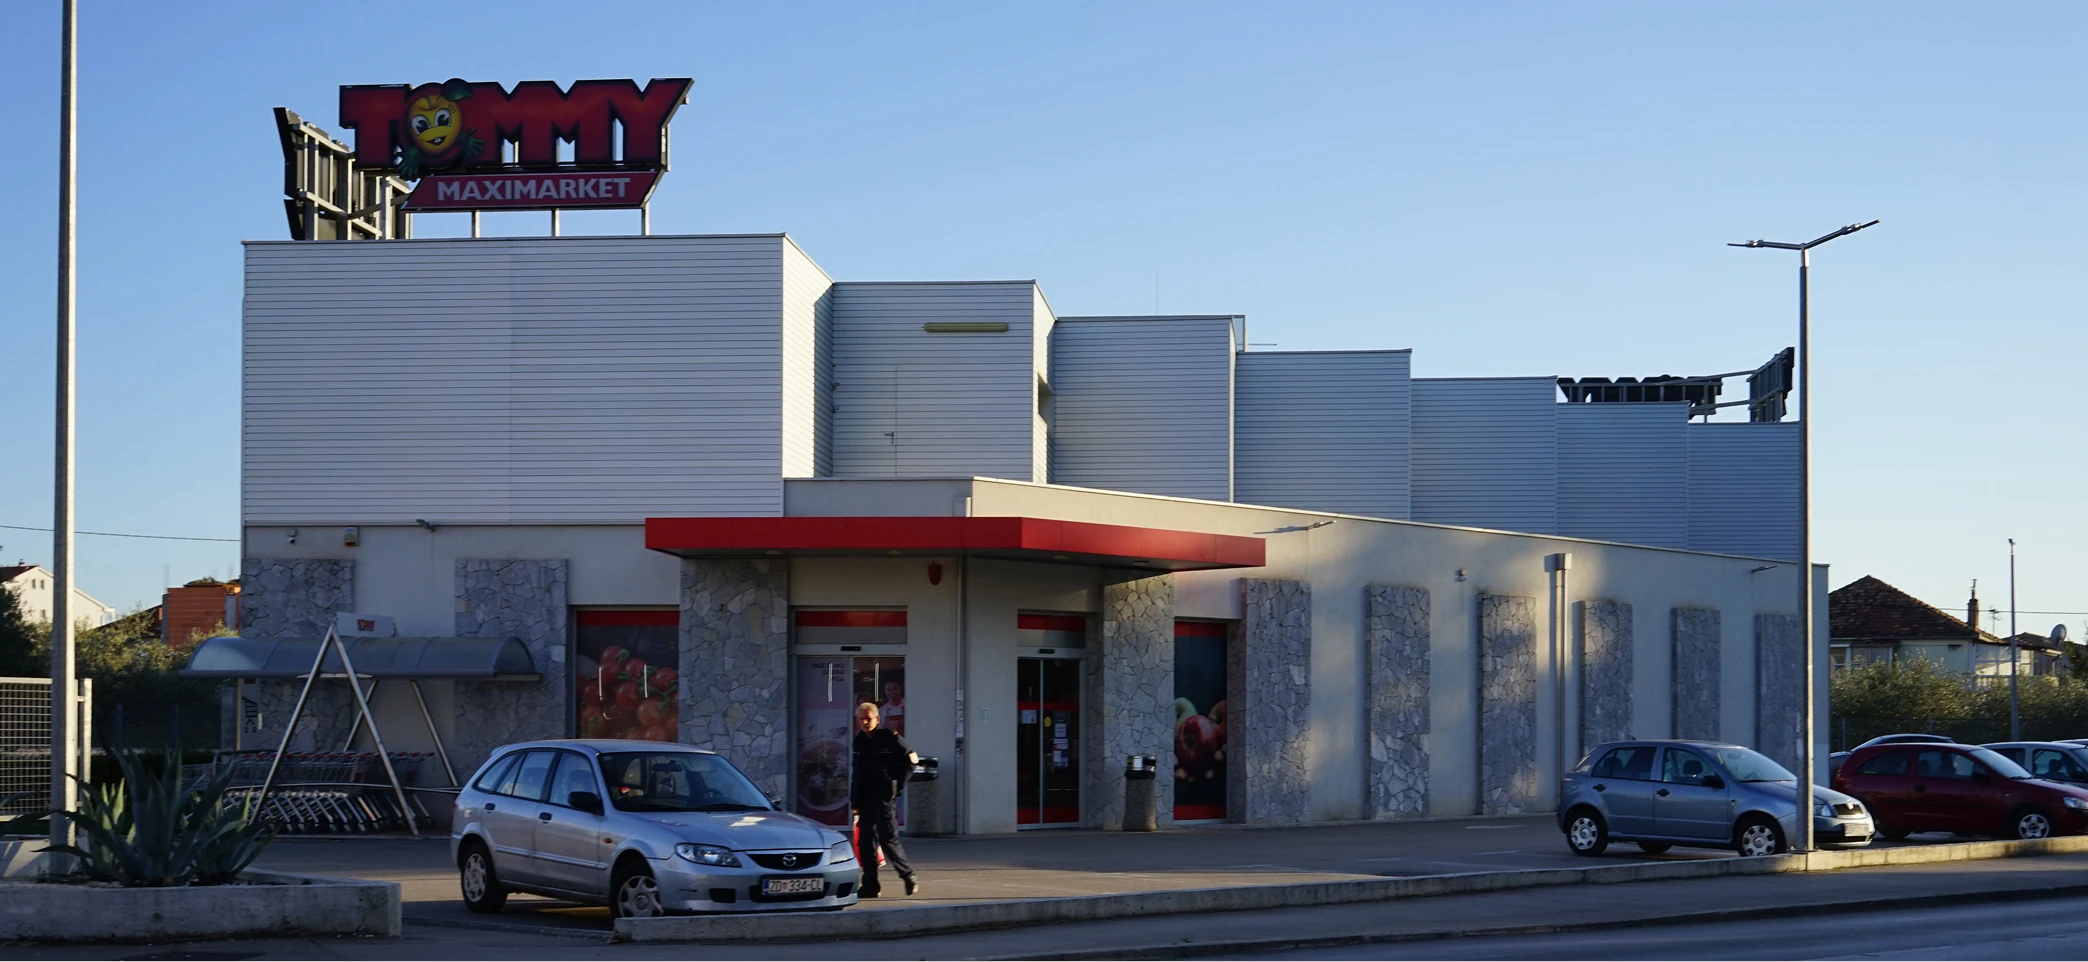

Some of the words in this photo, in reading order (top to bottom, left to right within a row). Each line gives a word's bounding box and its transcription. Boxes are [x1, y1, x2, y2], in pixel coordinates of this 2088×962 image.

[339, 77, 694, 169] TOMMY
[437, 178, 631, 202] MAXIMARKET
[770, 881, 782, 892] ZD
[789, 879, 822, 891] 334-CL
